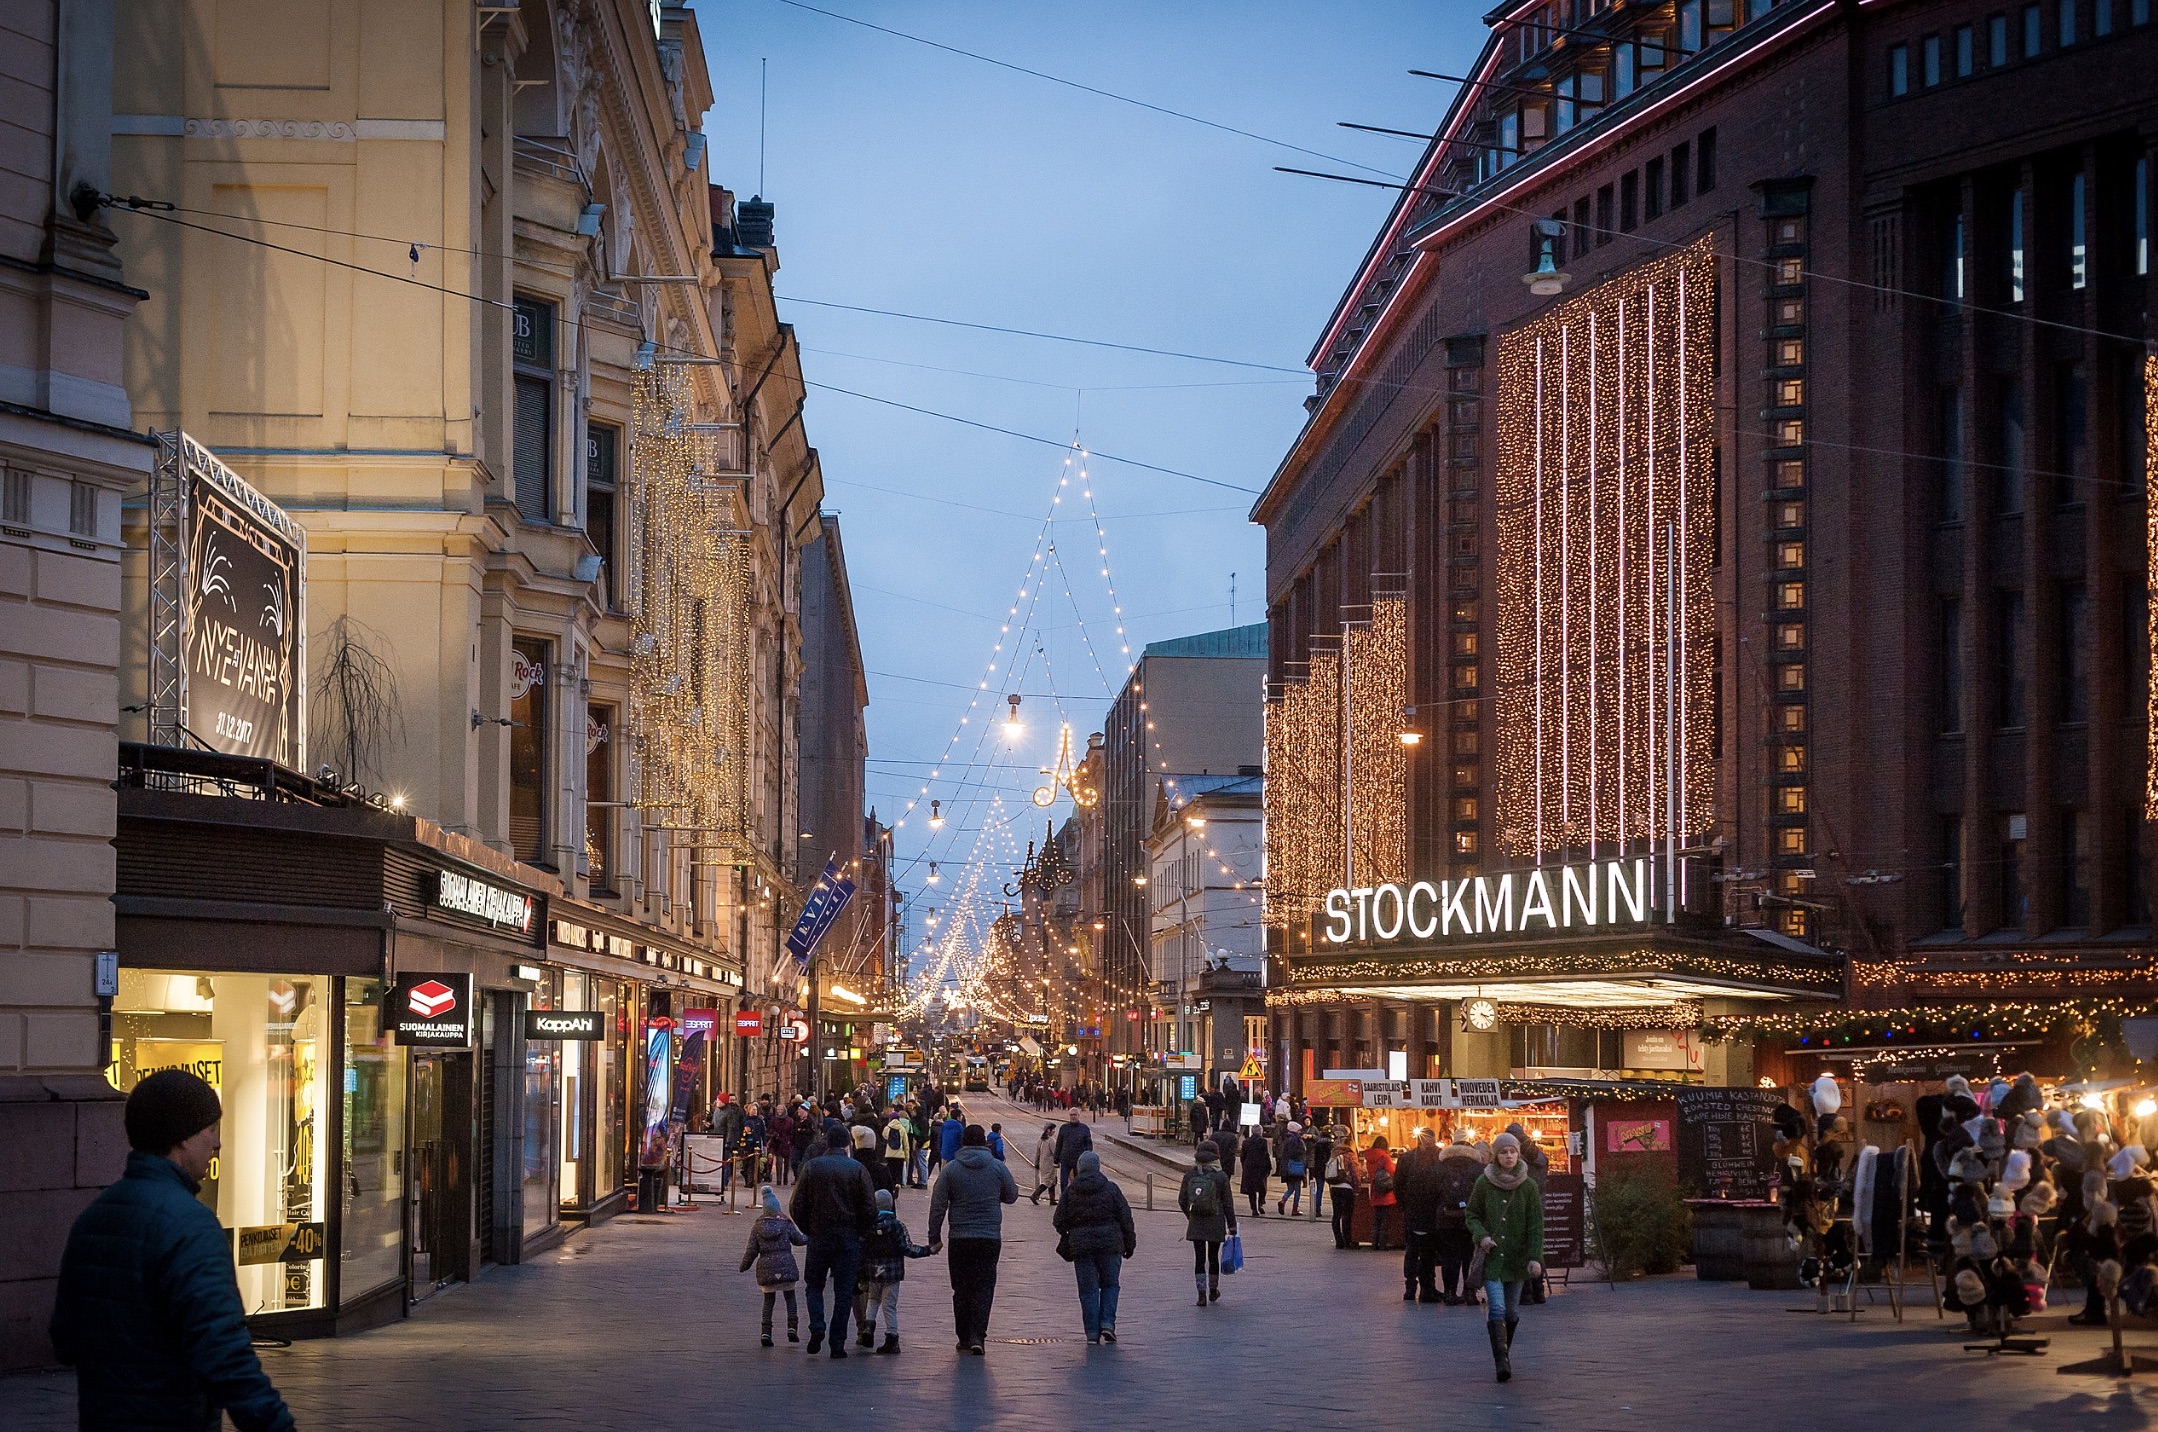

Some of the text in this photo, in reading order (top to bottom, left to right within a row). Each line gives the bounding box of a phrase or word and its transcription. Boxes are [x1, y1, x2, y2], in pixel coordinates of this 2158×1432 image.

[514, 662, 543, 681] Rock
[1325, 858, 1645, 943] STOCKMANN
[399, 1022, 464, 1032] SUOMALAINEN
[537, 1017, 593, 1033] KappAhl
[685, 1020, 714, 1029] ESPRIT
[737, 1020, 760, 1028] ESPRIT
[415, 1031, 464, 1039] KIRJAKAUPPA
[1363, 1082, 1401, 1093] SAARISTOLAIS
[1420, 1082, 1441, 1093] KAHVI
[1459, 1081, 1497, 1094] RUOVEDEN
[1373, 1092, 1392, 1106] LEIPÄ
[1421, 1094, 1442, 1107] KAKUT
[1461, 1095, 1500, 1107] HERKKUJA
[1677, 1091, 1723, 1105] KUUMIA
[1683, 1102, 1775, 1115] ROASTED CHESTNU
[240, 1227, 322, 1254] PENKOJAISET -40%
